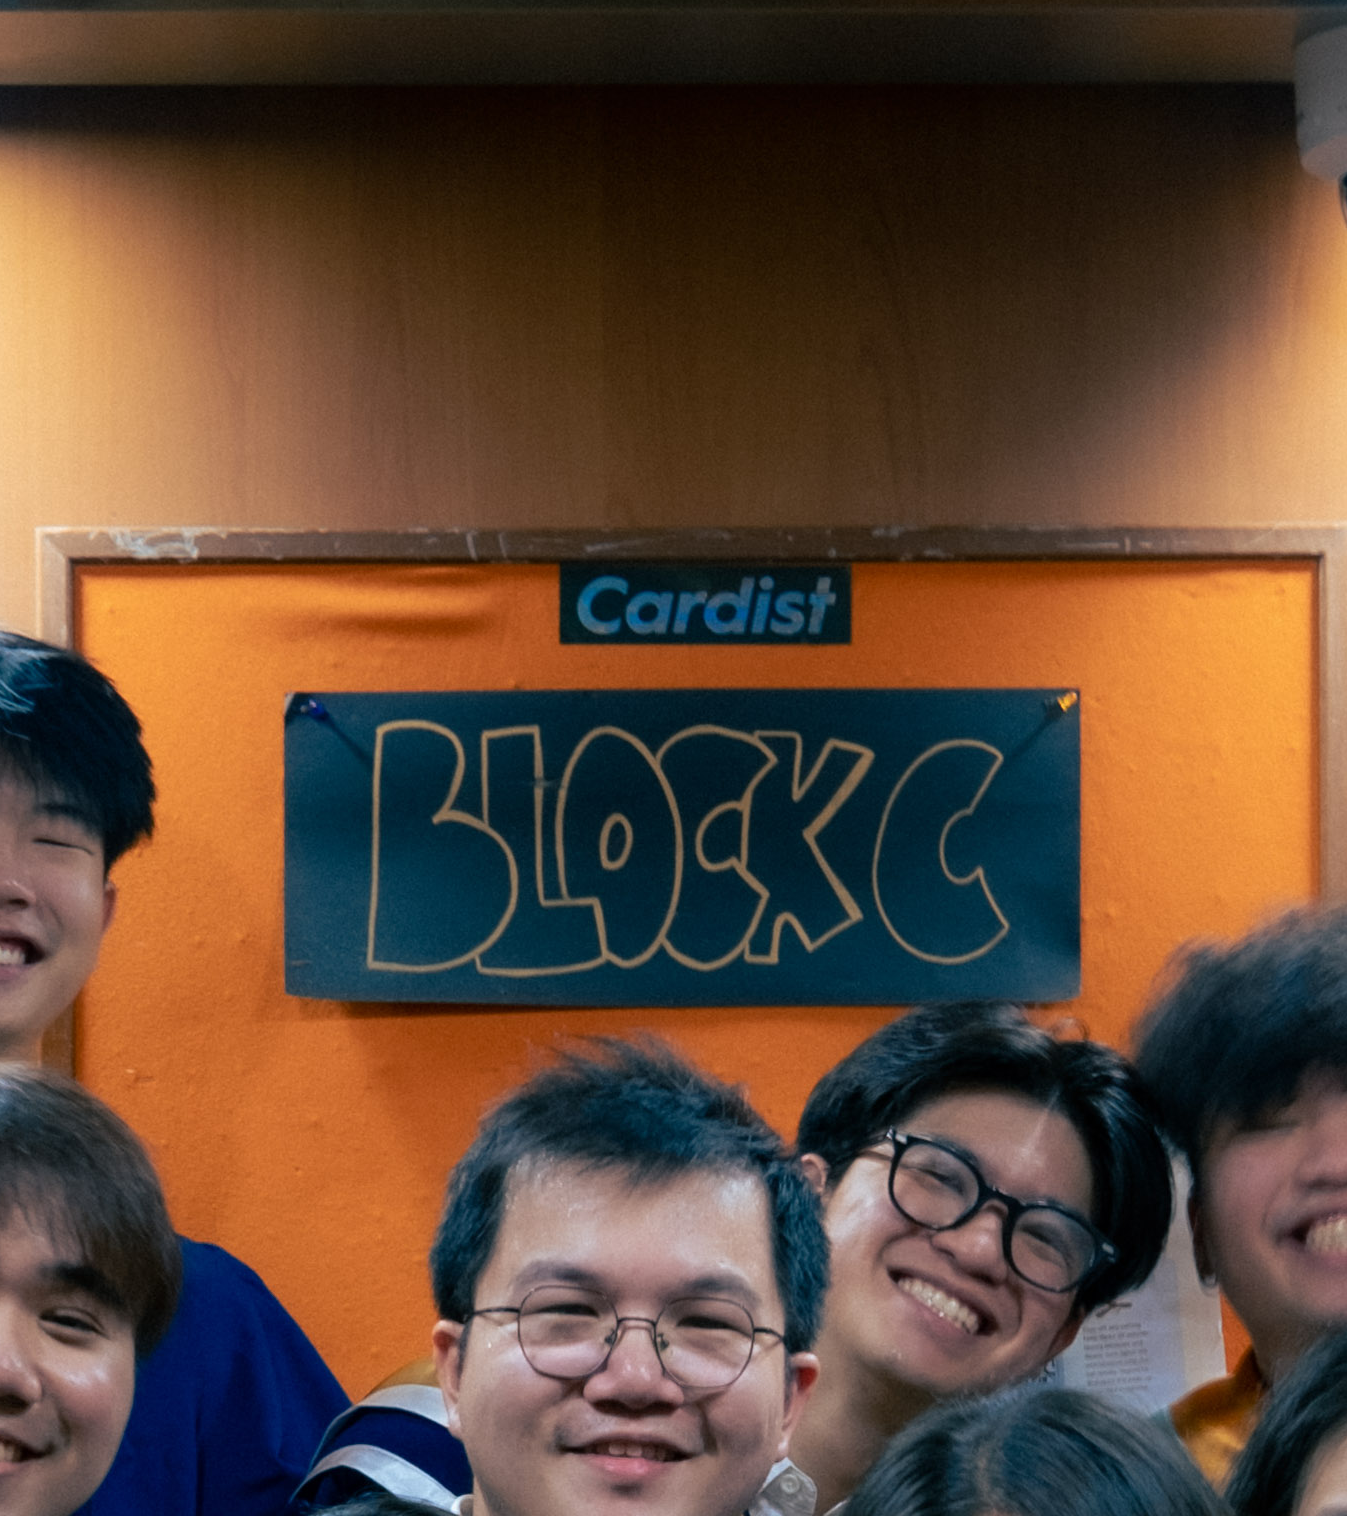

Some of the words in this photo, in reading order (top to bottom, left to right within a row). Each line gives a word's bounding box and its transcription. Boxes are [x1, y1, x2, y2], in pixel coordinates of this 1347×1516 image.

[577, 575, 837, 636] Cardist
[367, 719, 875, 976] BLOCK
[872, 738, 1010, 965] C
